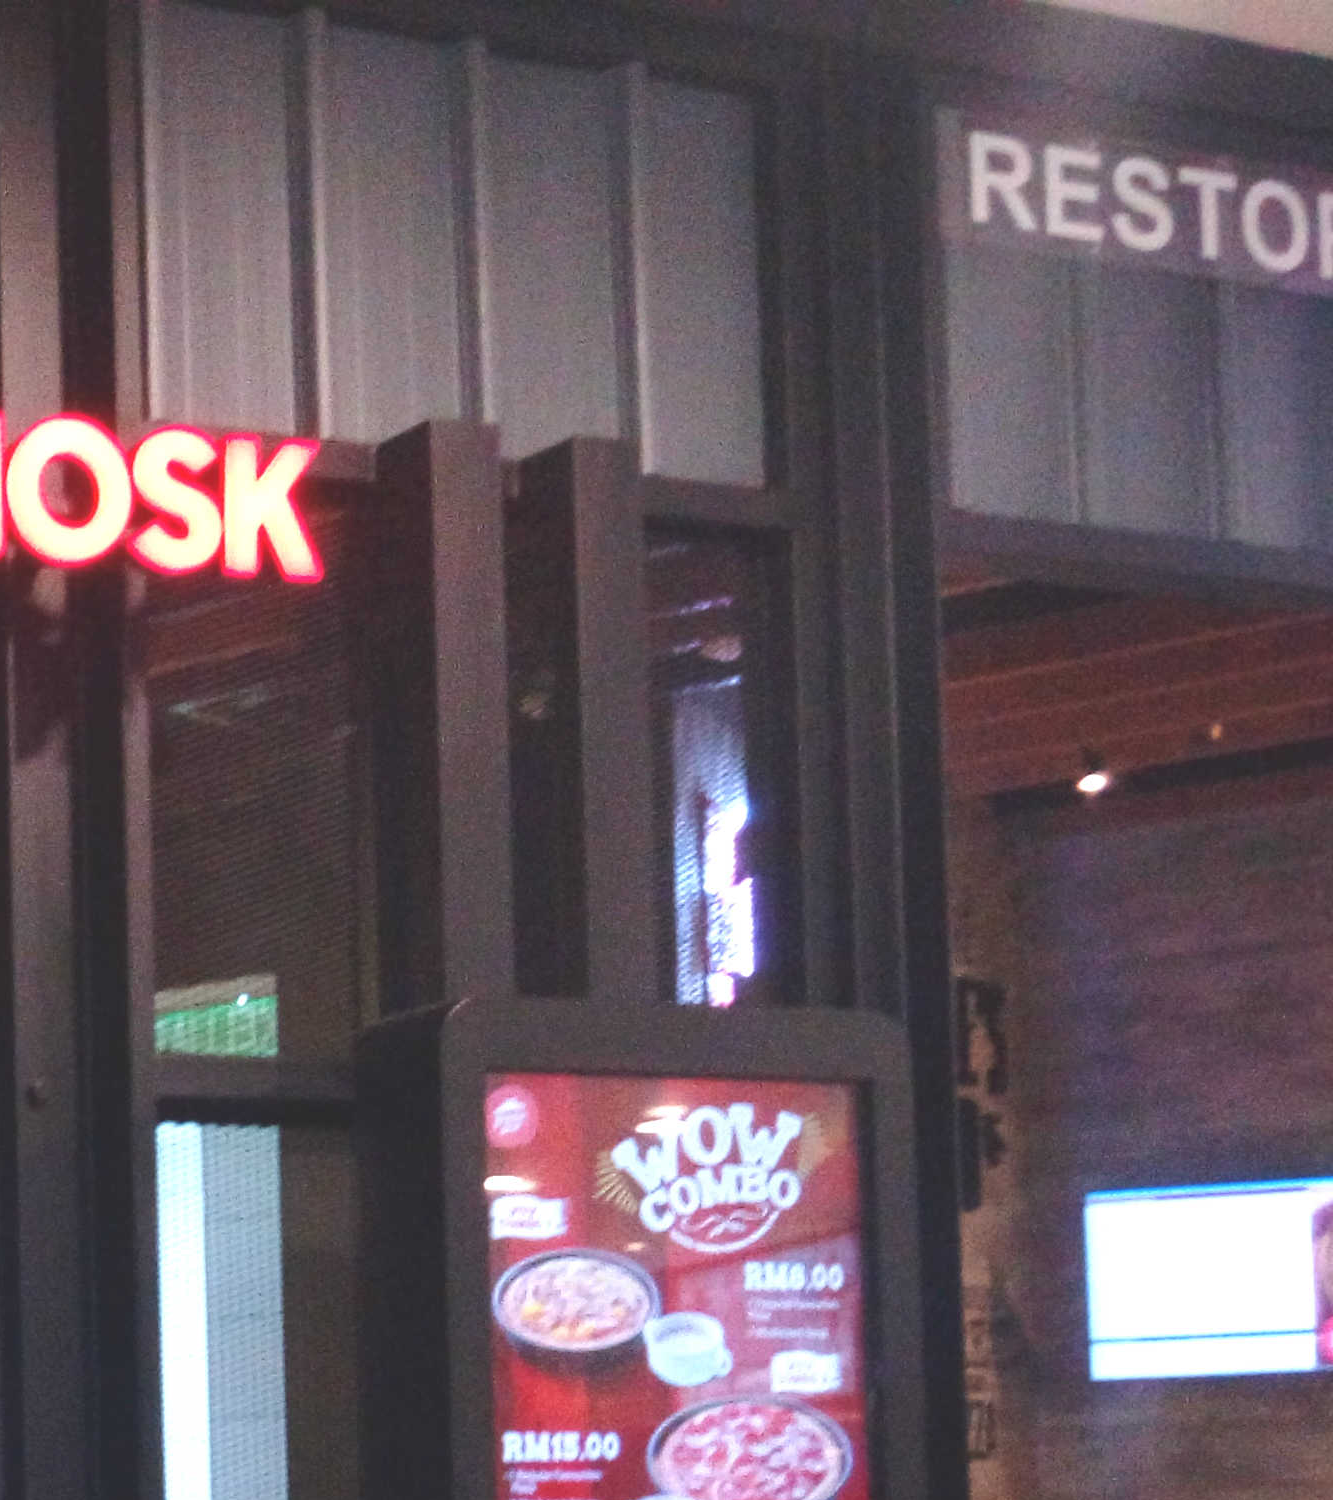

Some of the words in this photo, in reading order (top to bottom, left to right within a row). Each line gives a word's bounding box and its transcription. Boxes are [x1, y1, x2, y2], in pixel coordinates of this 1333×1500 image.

[968, 131, 1333, 280] RESTO
[611, 1102, 804, 1193] WOW
[639, 1163, 802, 1233] COMBO
